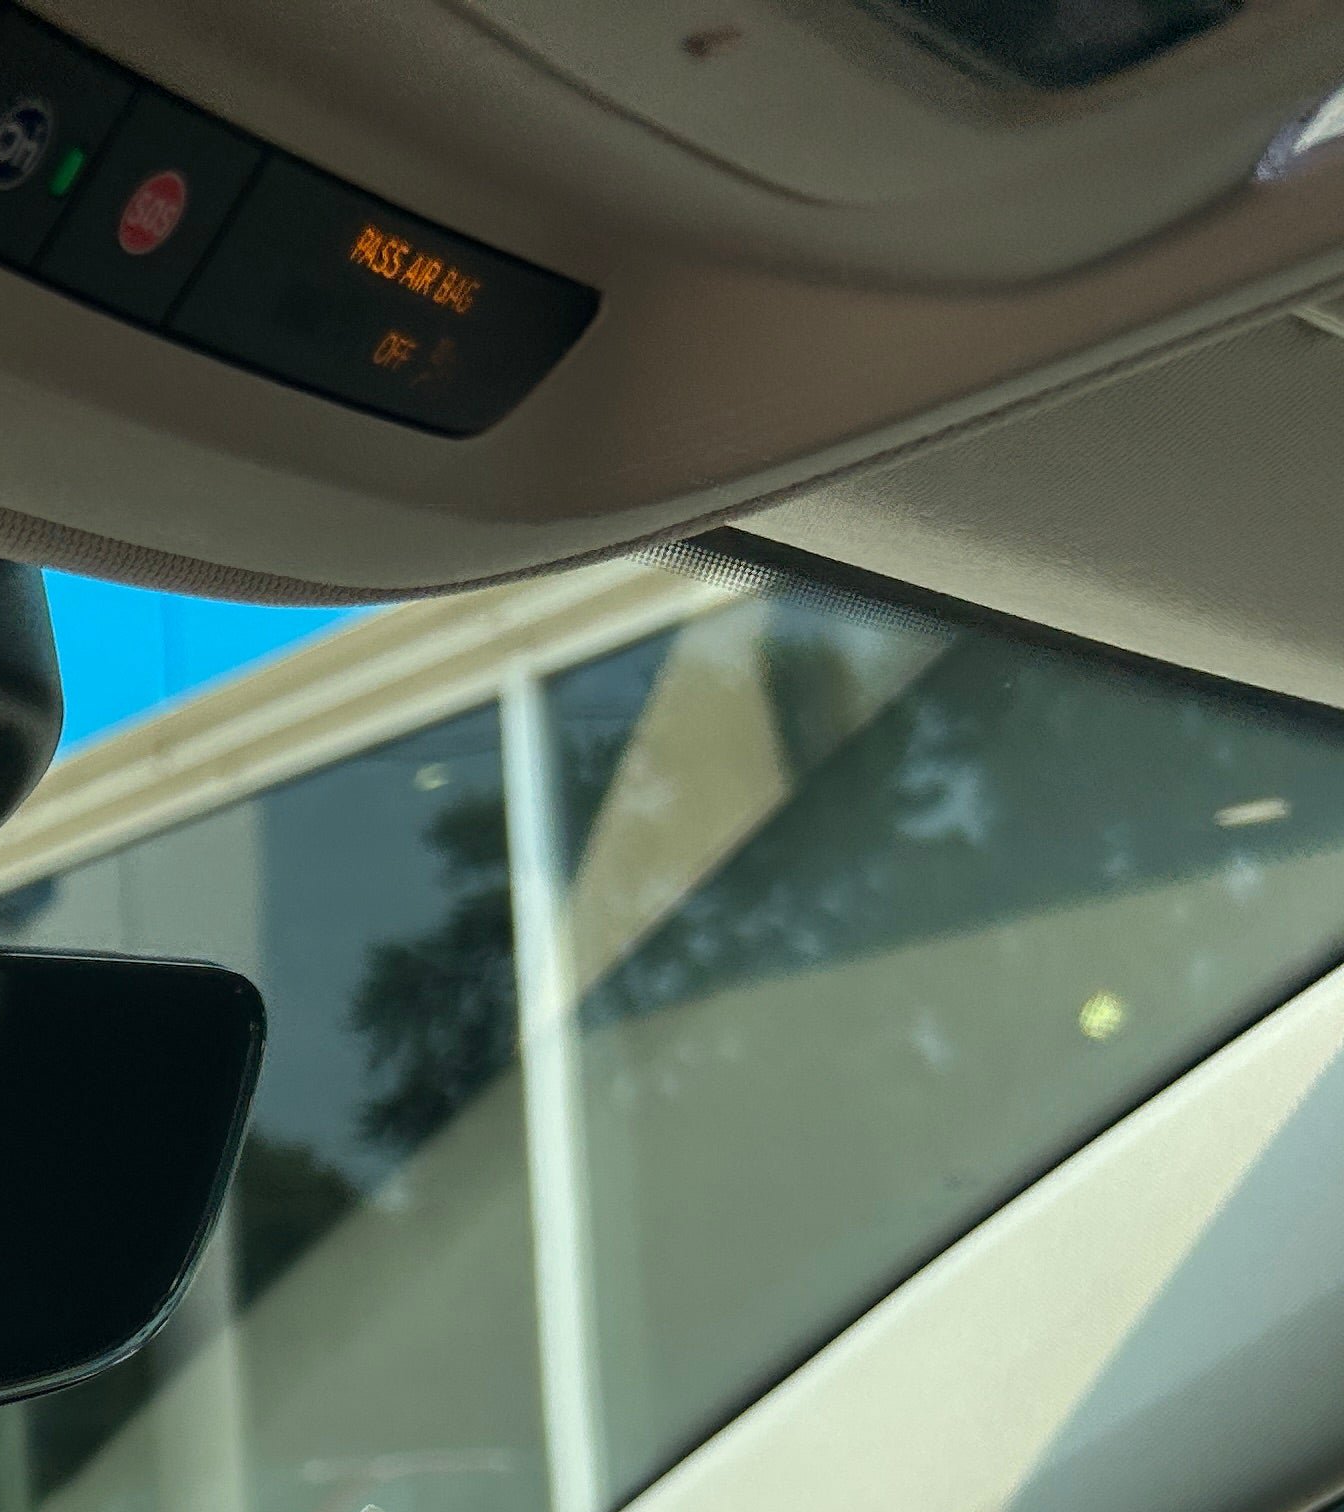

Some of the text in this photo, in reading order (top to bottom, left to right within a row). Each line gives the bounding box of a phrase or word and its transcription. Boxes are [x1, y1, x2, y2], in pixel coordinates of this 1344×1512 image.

[127, 190, 179, 238] SOS
[350, 224, 481, 314] PASS AIR BAG
[373, 331, 417, 370] OFF
